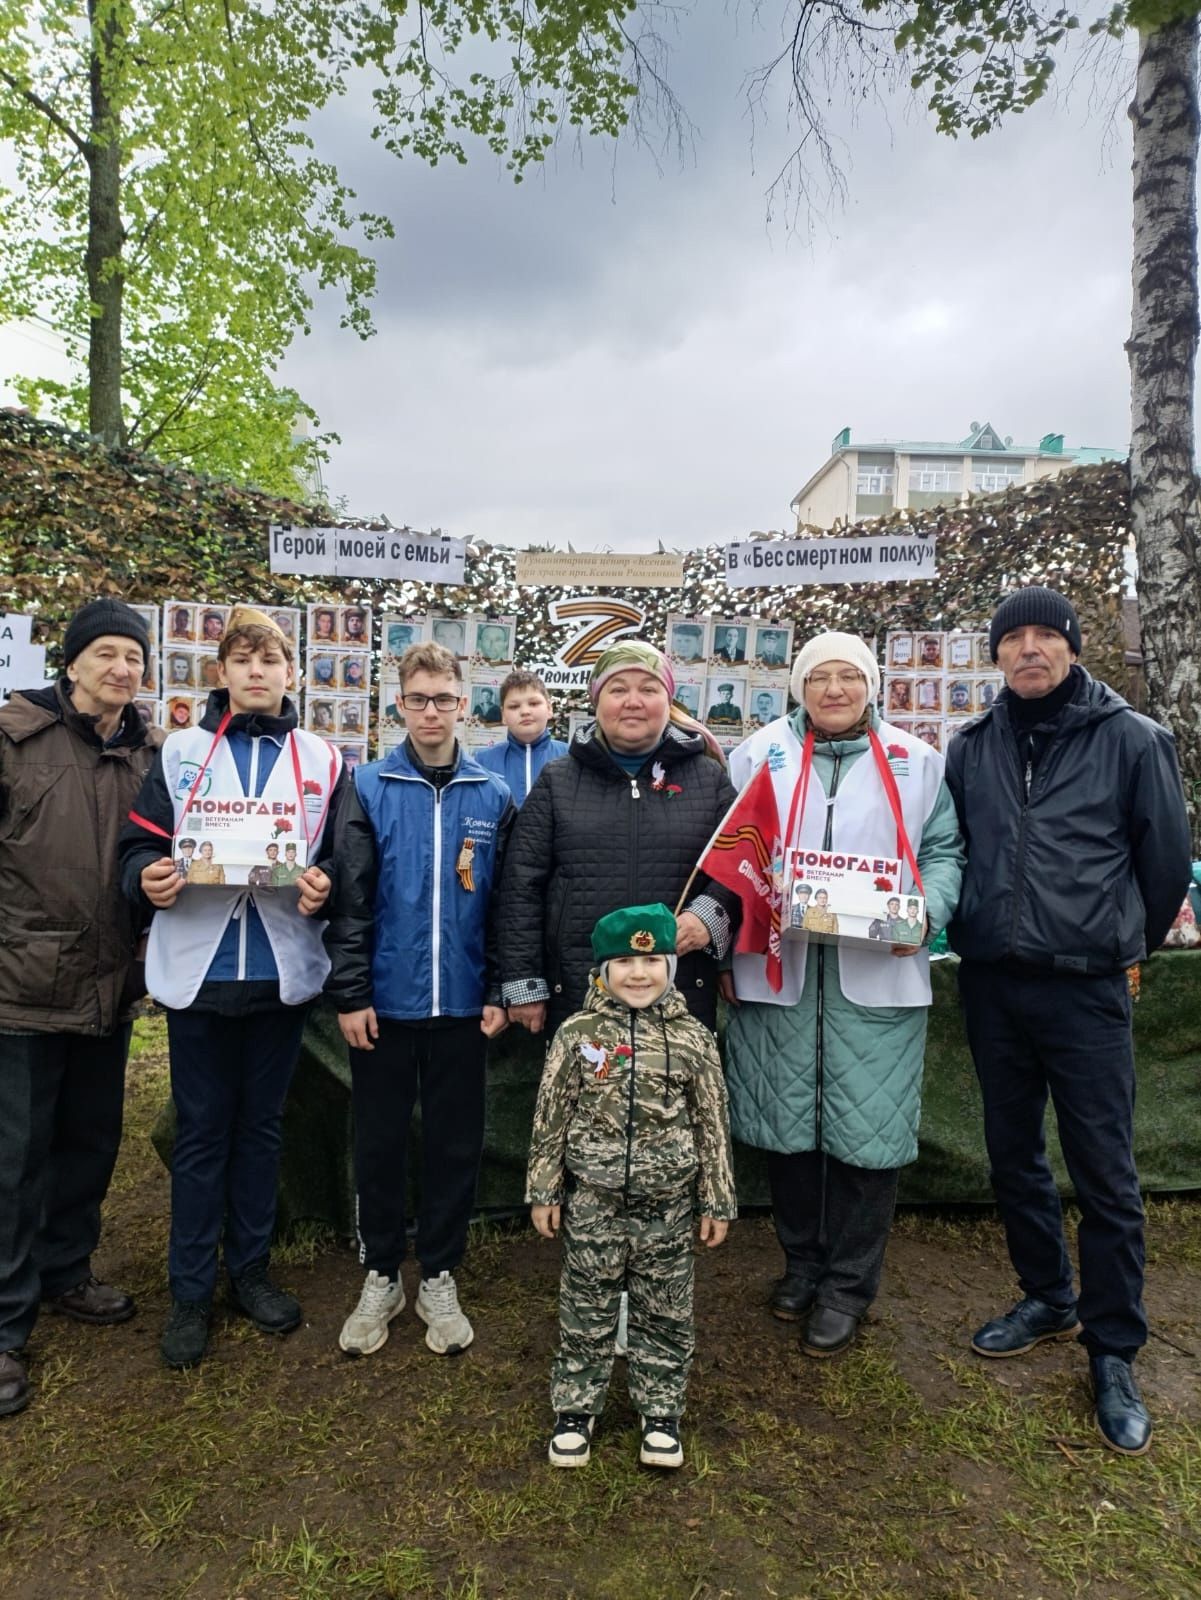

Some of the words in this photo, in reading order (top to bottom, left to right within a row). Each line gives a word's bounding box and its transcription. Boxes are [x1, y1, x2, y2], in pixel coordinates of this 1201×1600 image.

[273, 531, 326, 560] Герой
[338, 536, 386, 559] моей
[728, 552, 738, 569] в
[879, 543, 934, 566] полку»
[187, 799, 296, 815] ПОМОГАЕМ
[791, 851, 898, 875] ПОМОГАЕМ
